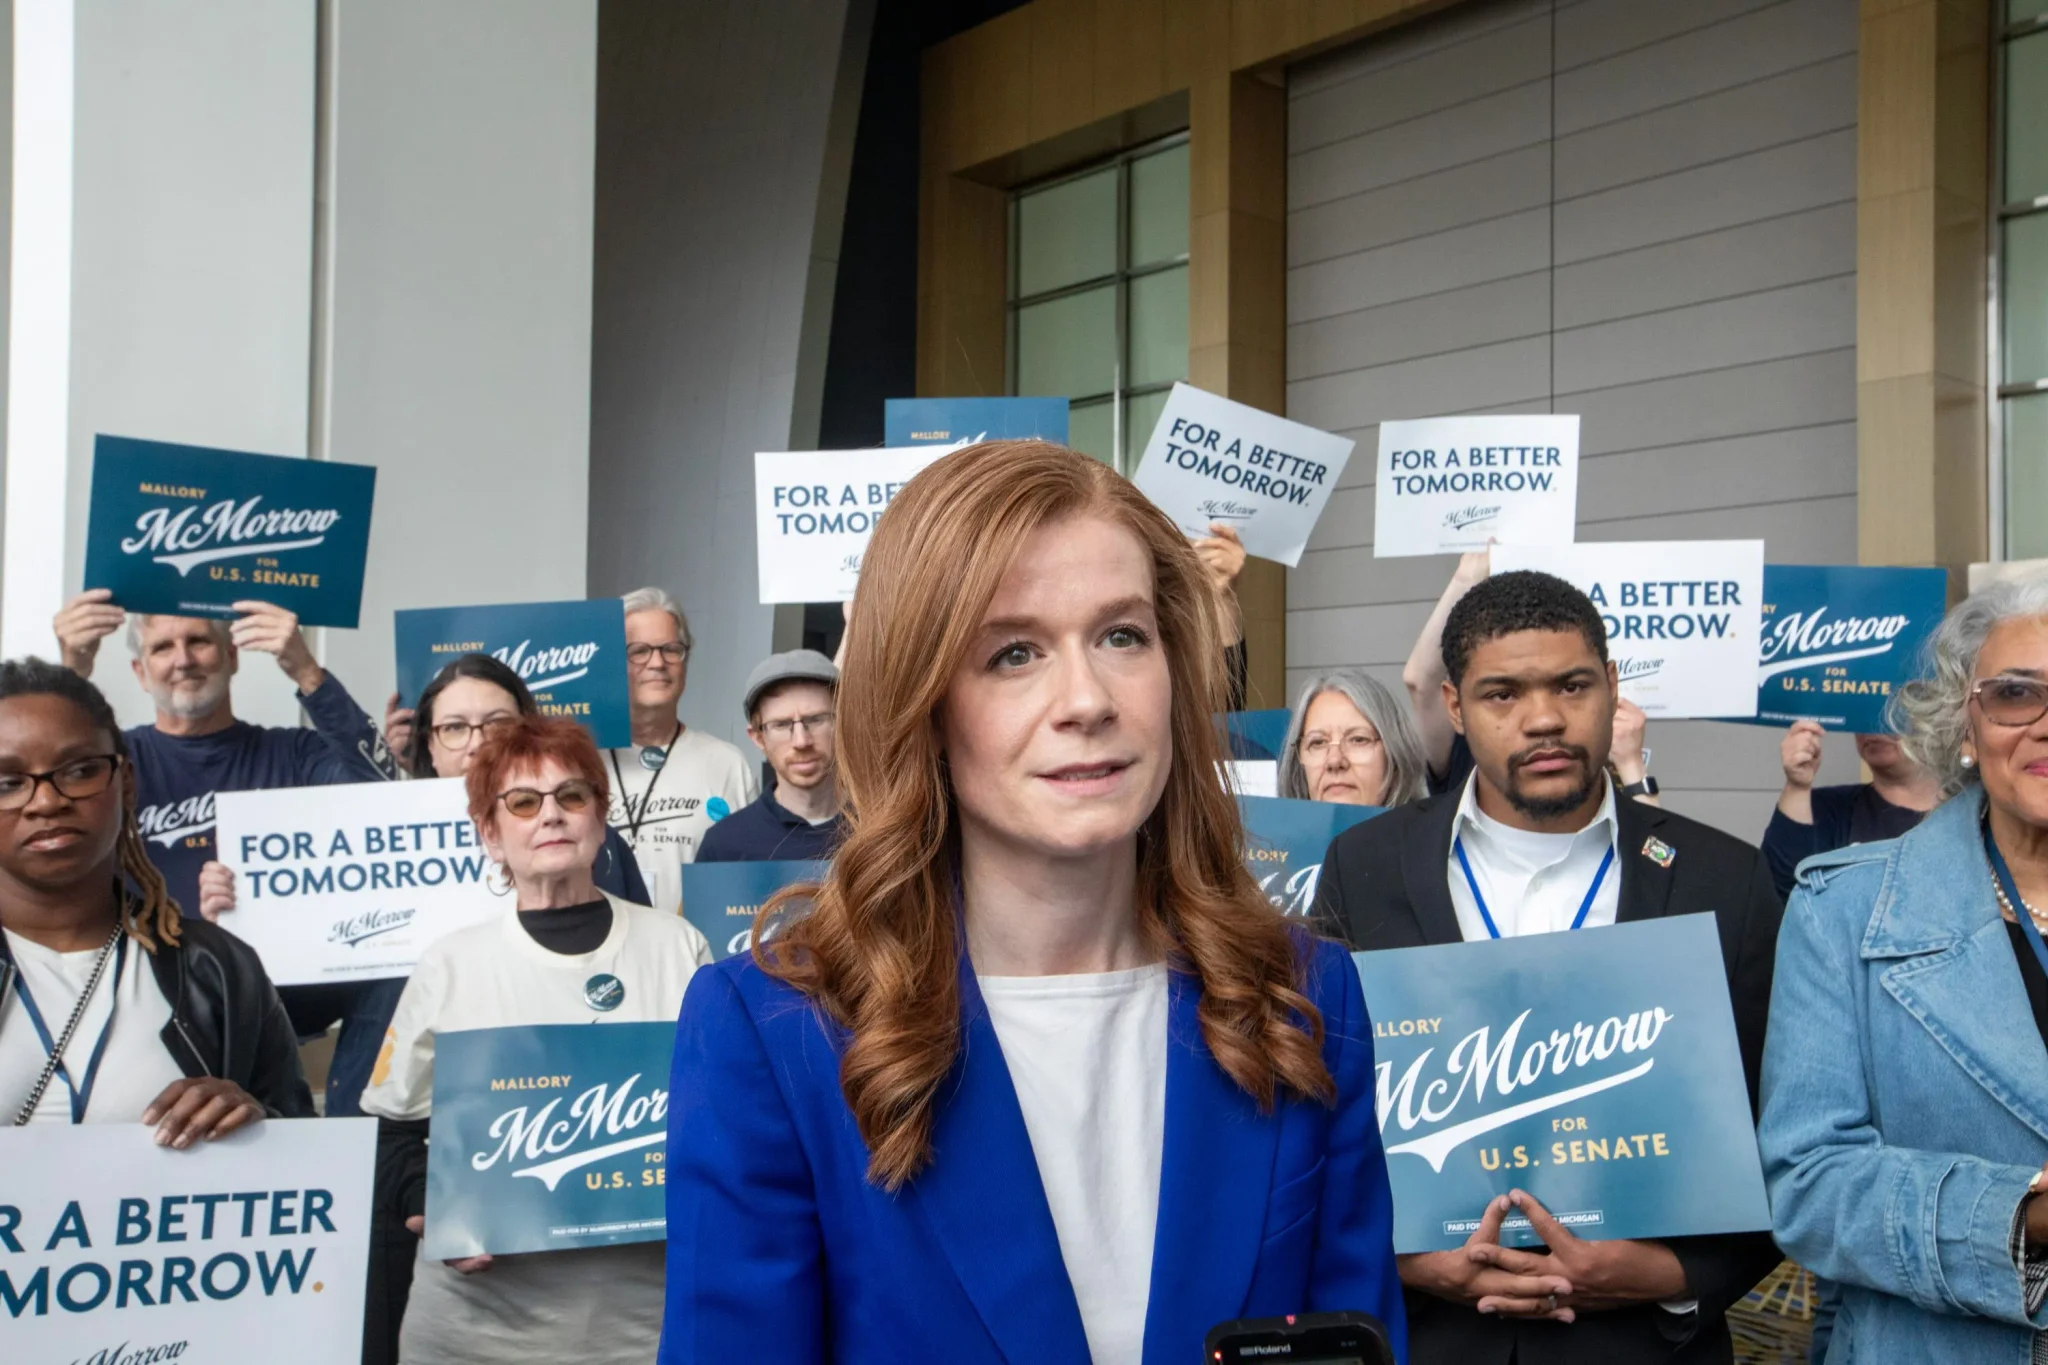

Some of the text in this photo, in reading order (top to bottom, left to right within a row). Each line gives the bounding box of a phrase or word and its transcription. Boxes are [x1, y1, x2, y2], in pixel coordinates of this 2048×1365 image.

[911, 431, 950, 440] MALLORY
[1169, 418, 1327, 485] FOR A BETTER
[1391, 447, 1561, 471] FOR A BETTER
[1165, 442, 1312, 507] TOMORROW.
[139, 482, 207, 499] MALLORY
[773, 485, 830, 507] FOR
[839, 484, 858, 506] A
[121, 495, 341, 554] McMorrow
[776, 511, 883, 535] TOMO
[256, 557, 279, 568] FOR
[209, 566, 320, 588] U.S. SENATE
[1589, 581, 1742, 607] A BETTER
[1601, 613, 1736, 640] ORROW.
[1760, 606, 1910, 662] cMorrow
[431, 641, 485, 653] MALLORY
[491, 639, 600, 680] Morrow
[1617, 656, 1664, 676] Morrow
[1825, 668, 1847, 677] FOR
[1783, 677, 1891, 695] U.S. SENATE
[138, 790, 215, 834] McMo
[241, 832, 317, 863] FOR
[328, 829, 353, 857] A
[653, 834, 692, 845] SENATE
[1248, 849, 1289, 863] LORY
[327, 908, 415, 941] McMorrow
[1374, 1017, 1443, 1038] LLORY
[490, 1075, 572, 1091] MALLORY
[472, 1073, 668, 1171] McMor
[1552, 1117, 1588, 1133] FOR
[644, 1152, 666, 1164] FO
[1479, 1133, 1670, 1172] U.S. SENATE
[586, 1172, 632, 1190] U.S.
[44, 1200, 92, 1250] A
[115, 1188, 338, 1246] BETTER
[1447, 1223, 1465, 1232] PAID
[1559, 1214, 1600, 1224] MICHIGAN
[0, 1247, 324, 1319] MORROW.
[1253, 1344, 1291, 1356] Roland
